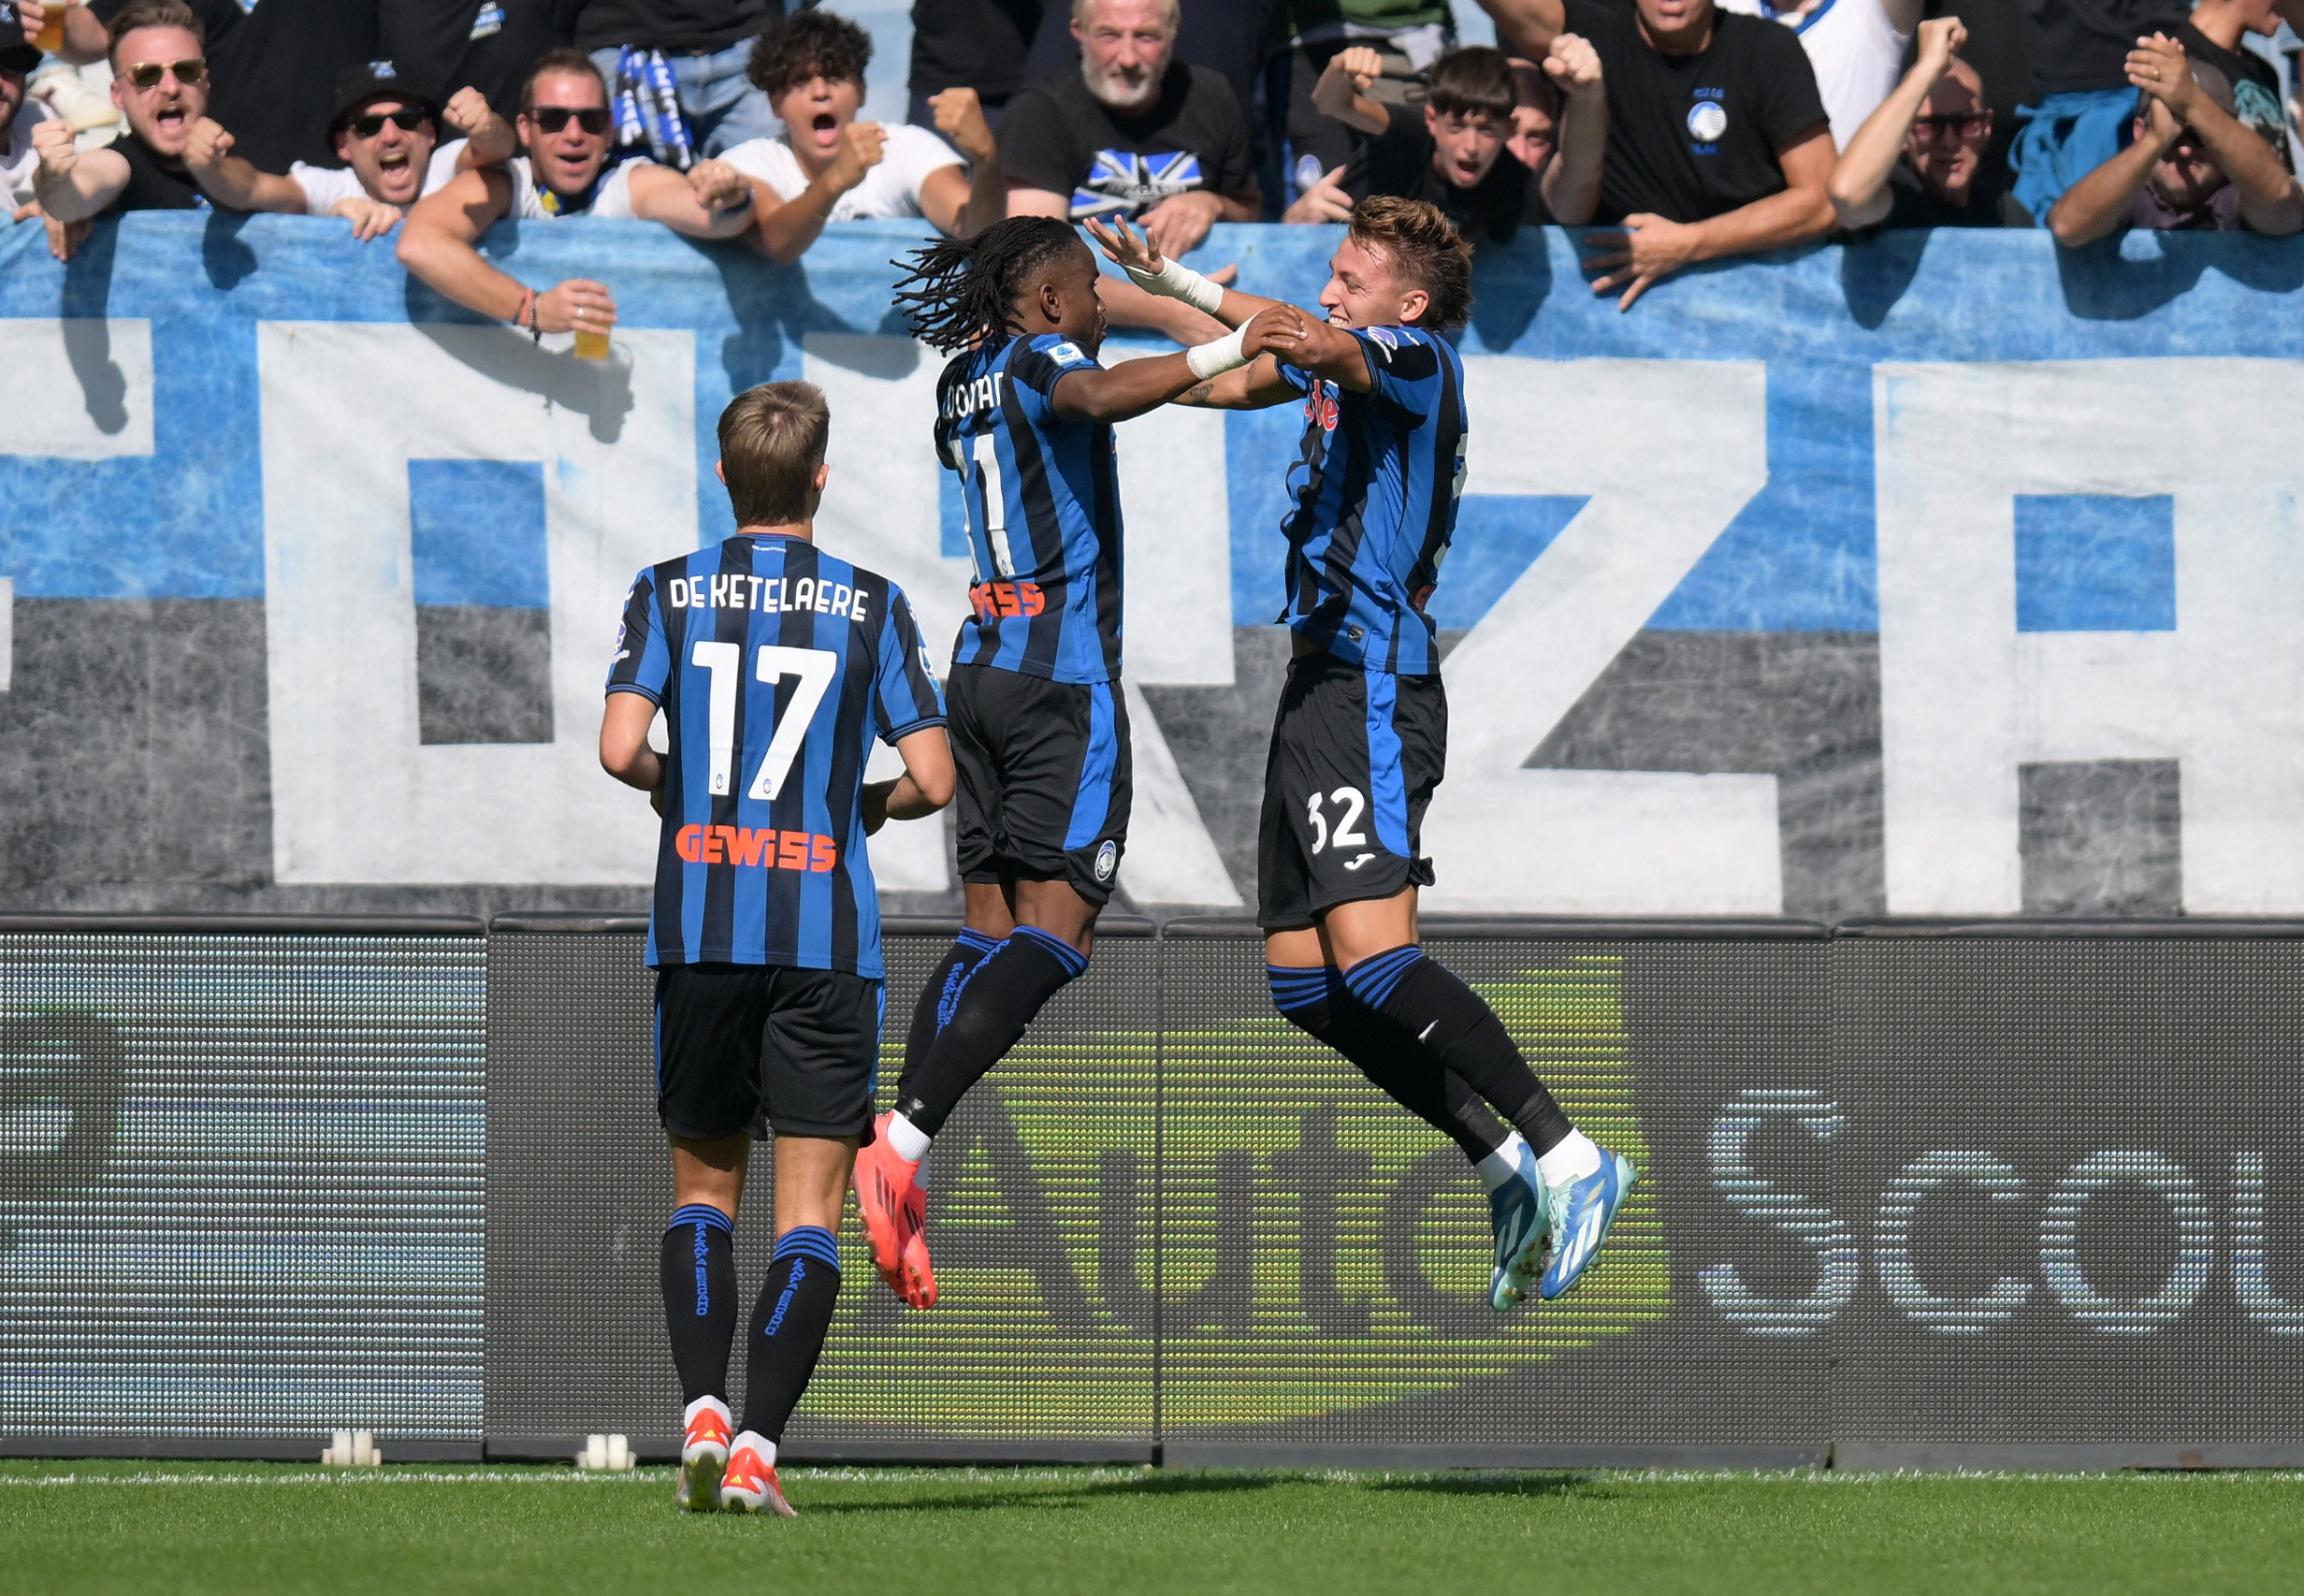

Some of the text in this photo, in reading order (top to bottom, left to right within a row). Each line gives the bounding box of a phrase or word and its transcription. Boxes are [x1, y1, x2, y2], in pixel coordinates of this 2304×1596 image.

[0, 316, 2304, 917] ORZA
[710, 573, 869, 622] KETELAERE
[691, 641, 837, 801] 17
[1308, 787, 1367, 854] 32
